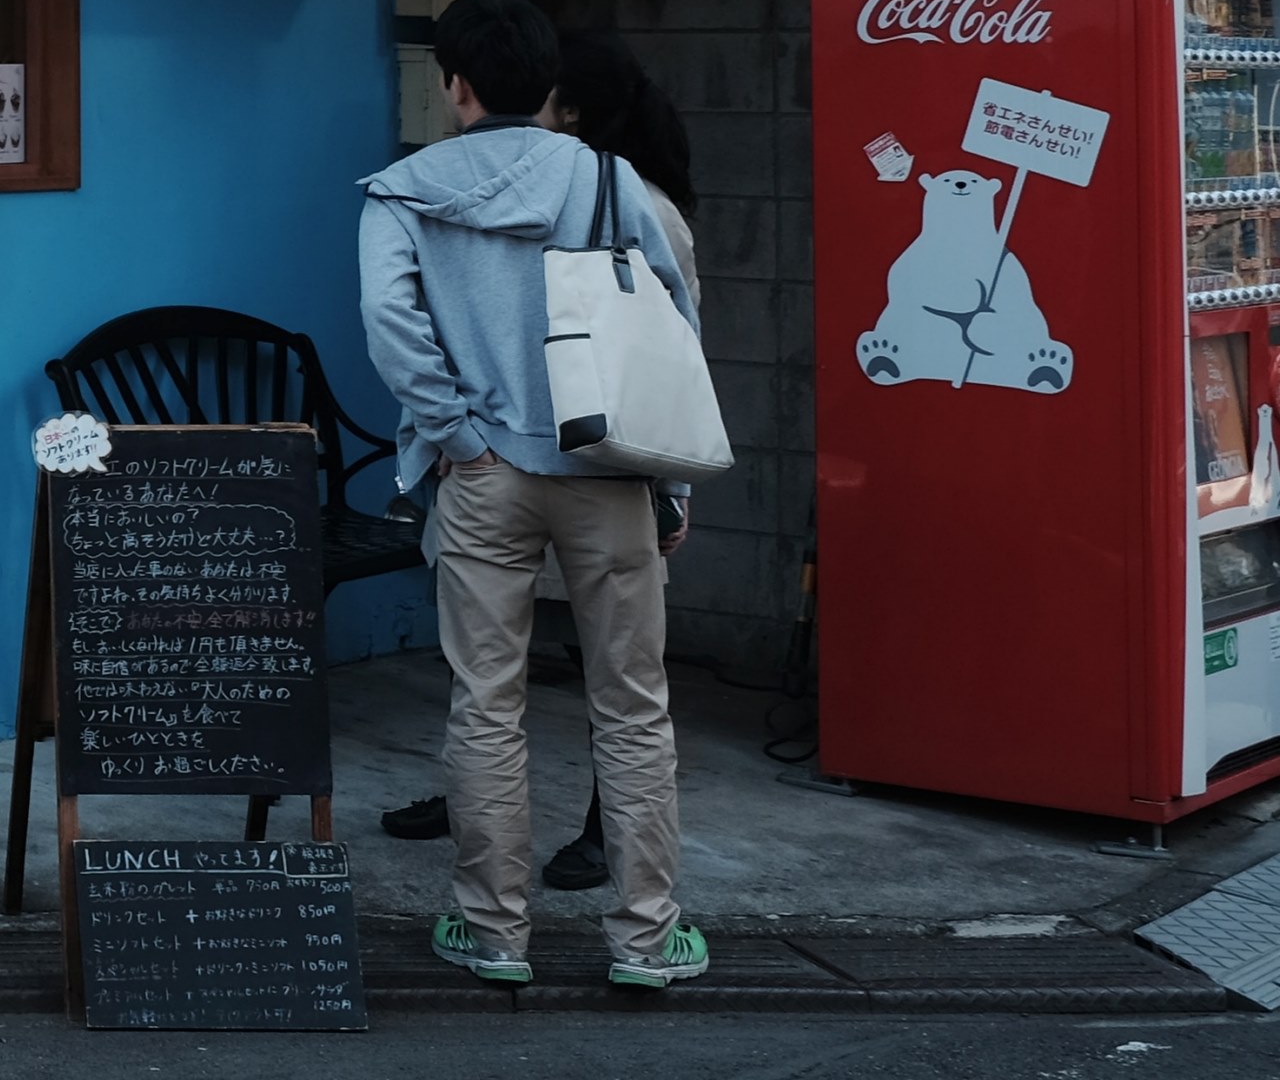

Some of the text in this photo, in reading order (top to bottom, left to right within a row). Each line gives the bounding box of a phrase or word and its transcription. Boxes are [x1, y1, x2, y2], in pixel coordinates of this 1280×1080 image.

[42, 430, 99, 458] ソフトクリーム
[83, 848, 181, 871] LUNCH
